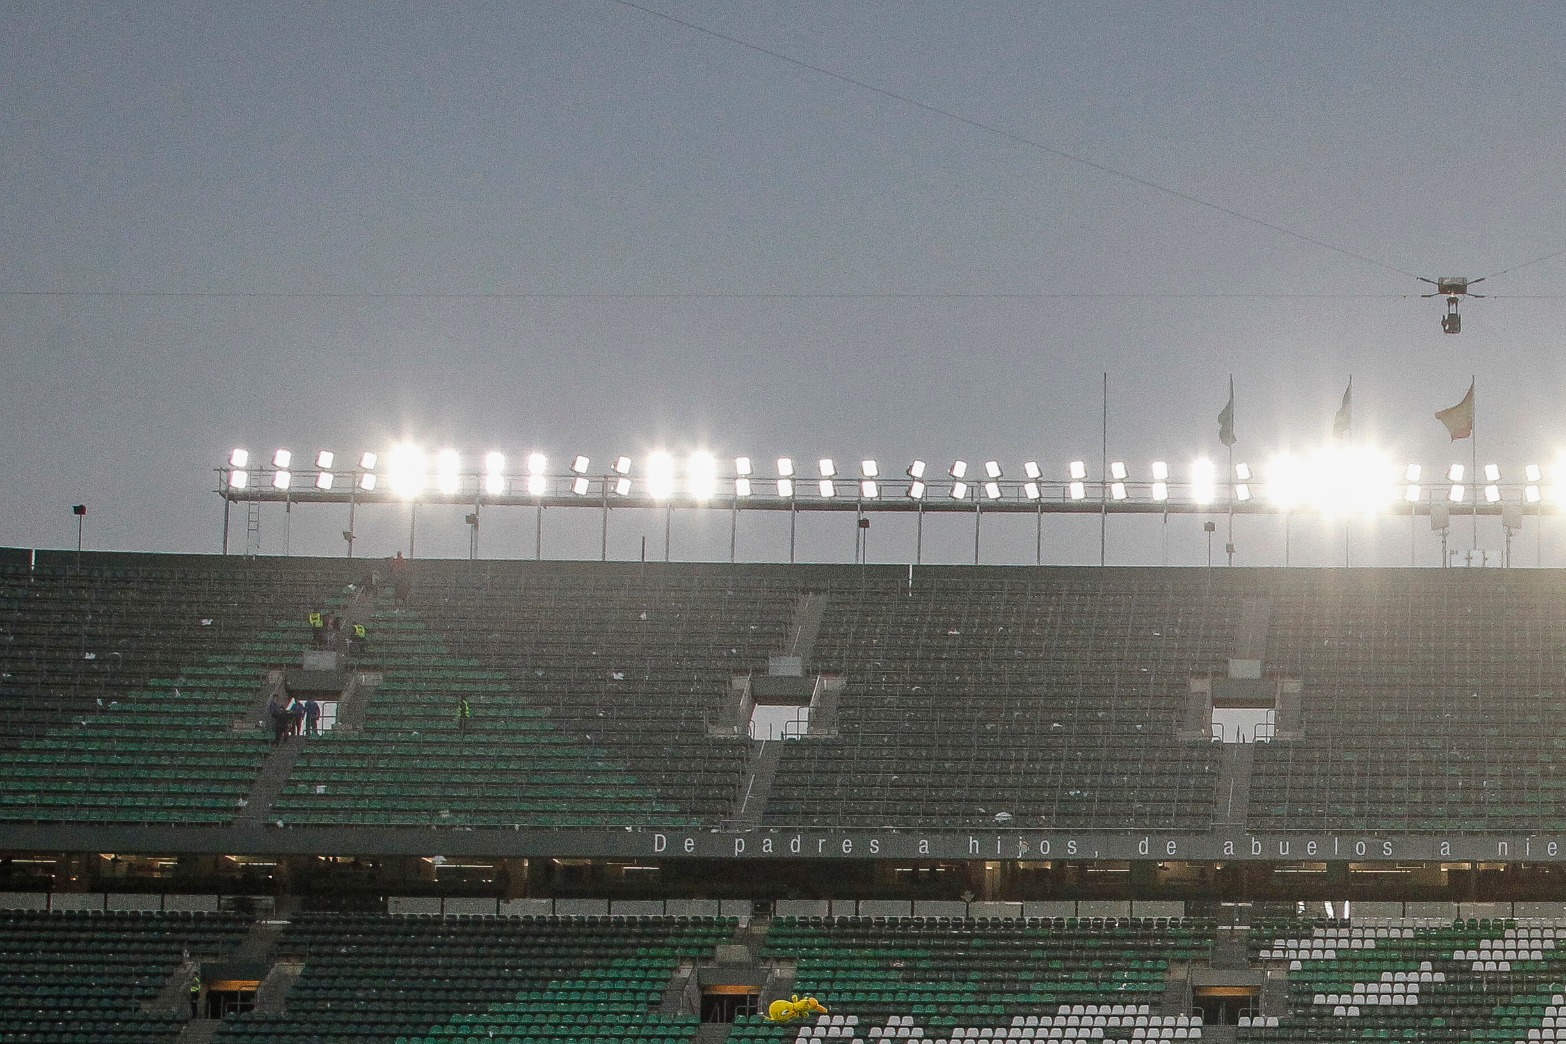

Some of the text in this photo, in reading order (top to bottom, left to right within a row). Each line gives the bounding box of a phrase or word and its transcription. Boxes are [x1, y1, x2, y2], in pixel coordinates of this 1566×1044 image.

[654, 834, 695, 854] De
[734, 834, 880, 857] padres
[918, 839, 930, 854] a
[969, 837, 1099, 859] hijos,
[1138, 837, 1177, 856] de
[1223, 837, 1393, 856] abuelos
[1440, 841, 1451, 856] a
